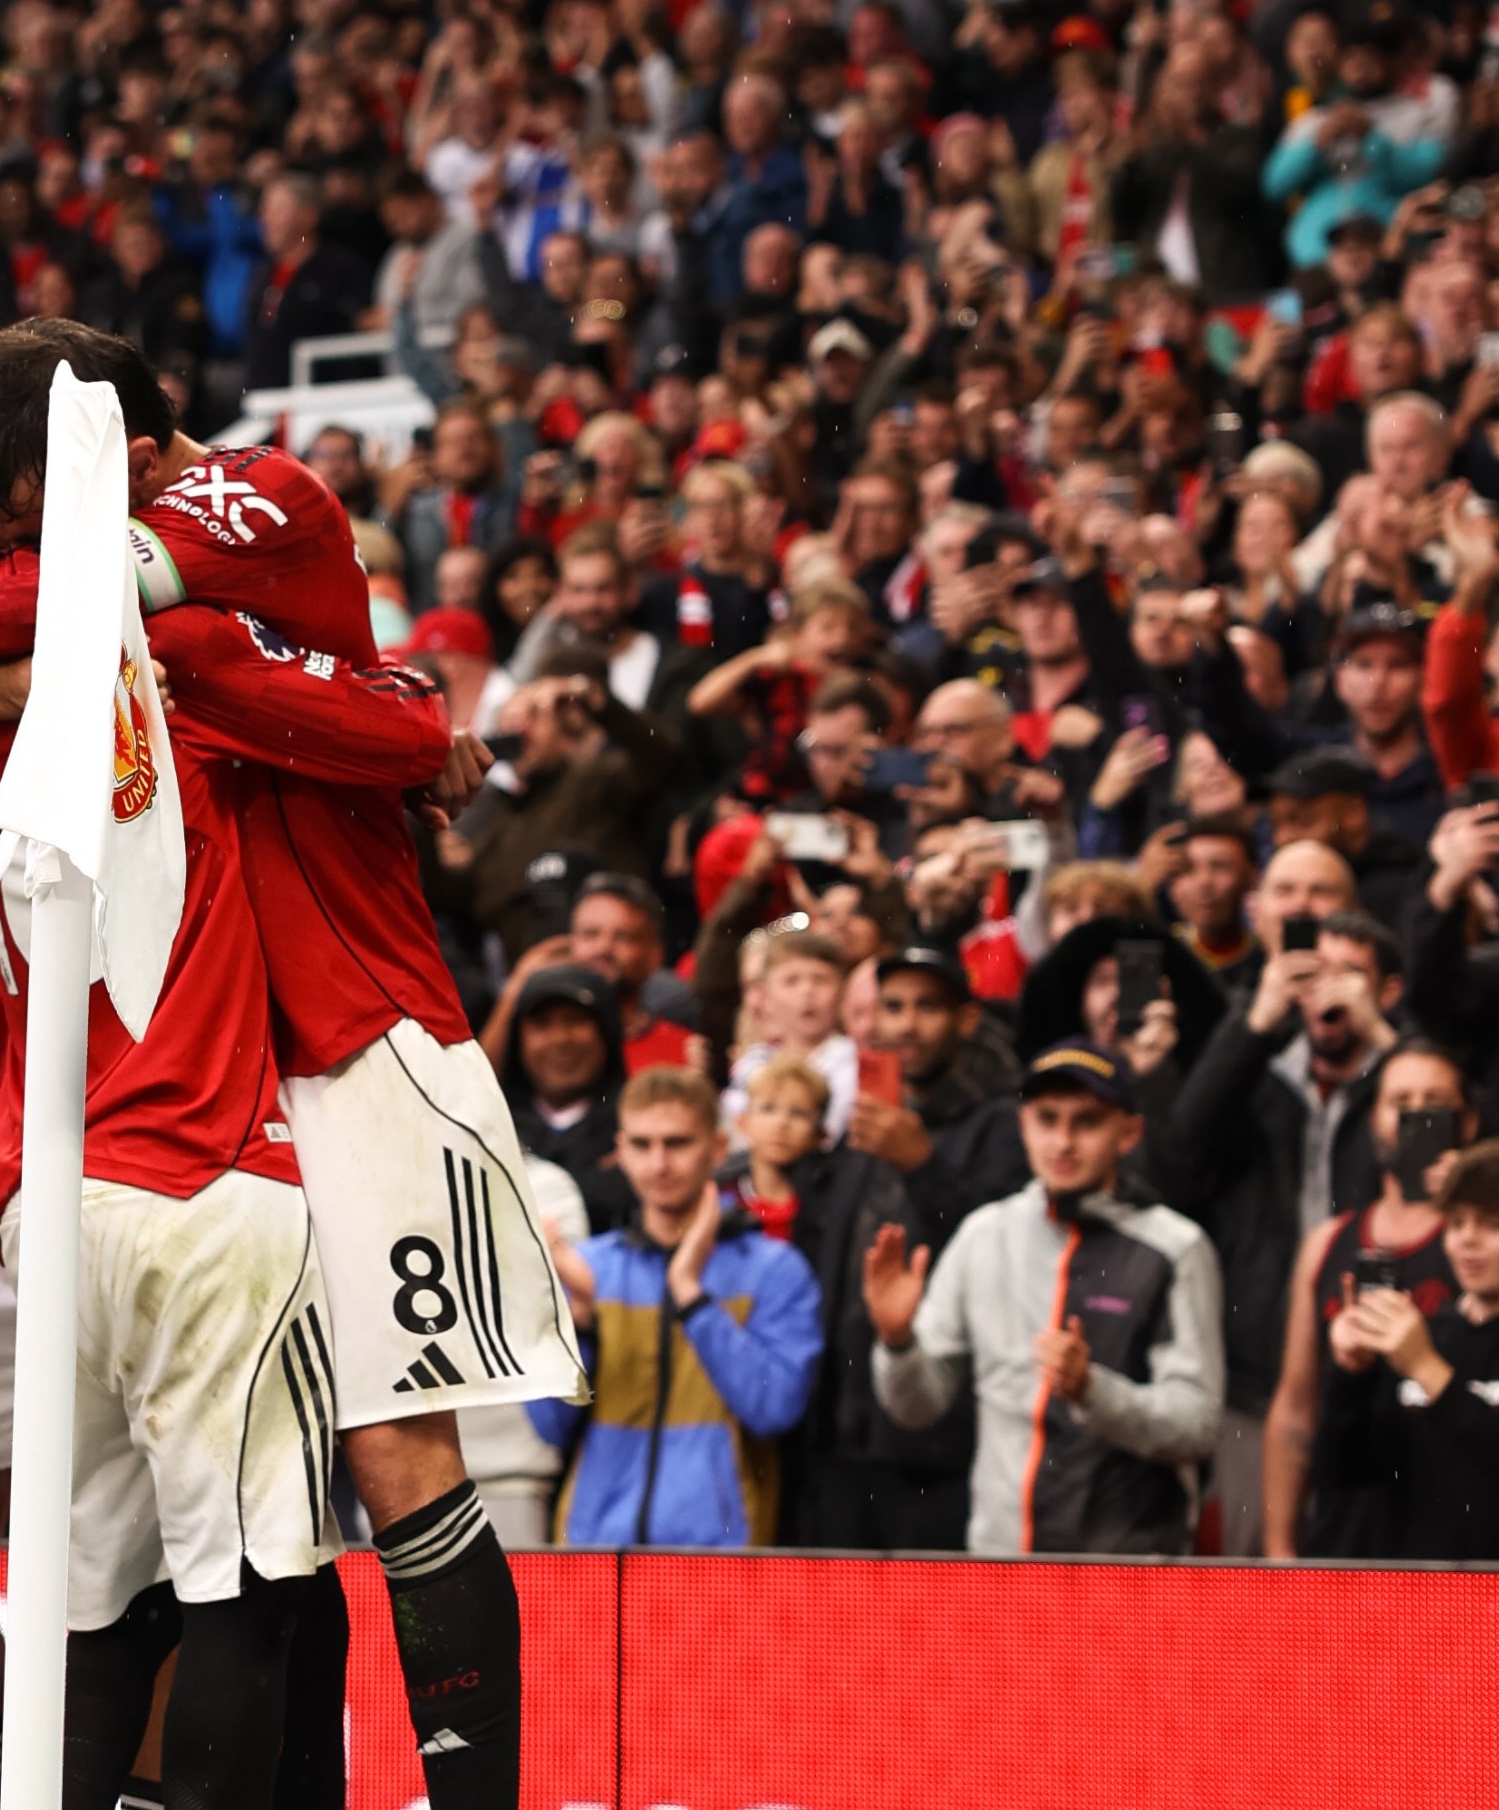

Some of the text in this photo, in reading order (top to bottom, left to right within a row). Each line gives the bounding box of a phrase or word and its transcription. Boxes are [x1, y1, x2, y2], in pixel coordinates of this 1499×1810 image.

[121, 728, 151, 812] UNITED
[389, 1234, 458, 1336] 8
[408, 1670, 480, 1700] UFC
